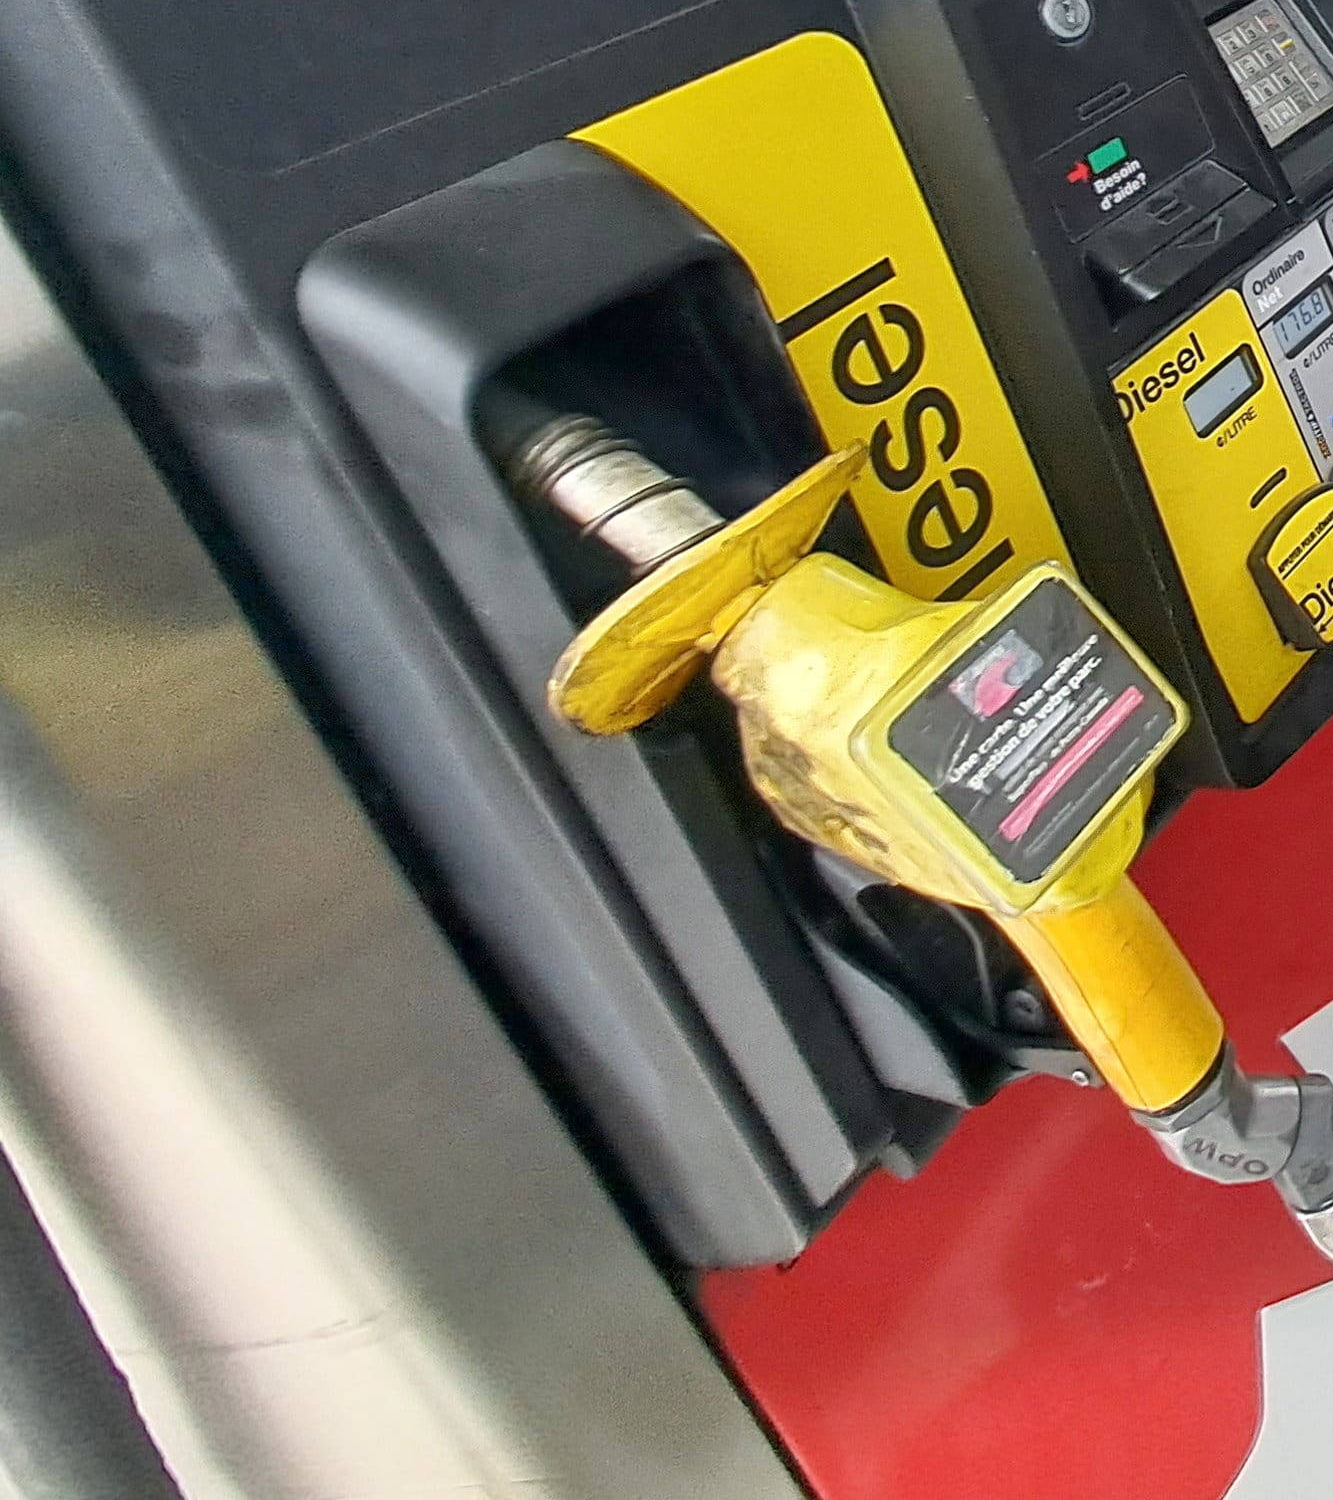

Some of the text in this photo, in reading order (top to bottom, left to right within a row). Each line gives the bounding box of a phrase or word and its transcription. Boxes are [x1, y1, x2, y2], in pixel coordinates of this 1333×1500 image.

[1093, 160, 1142, 194] Besoin
[1100, 172, 1147, 211] d'aide?
[1252, 250, 1305, 297] Ordinaire
[1257, 286, 1284, 314] Net
[1278, 291, 1325, 343] 176.8
[1114, 331, 1205, 424] Diesel
[1215, 406, 1258, 448] ¢/LITRE
[949, 754, 979, 783] Une
[1015, 688, 1044, 716] Une
[967, 655, 1103, 790] gestion de votre parc.
[1183, 1137, 1269, 1175] OPW
